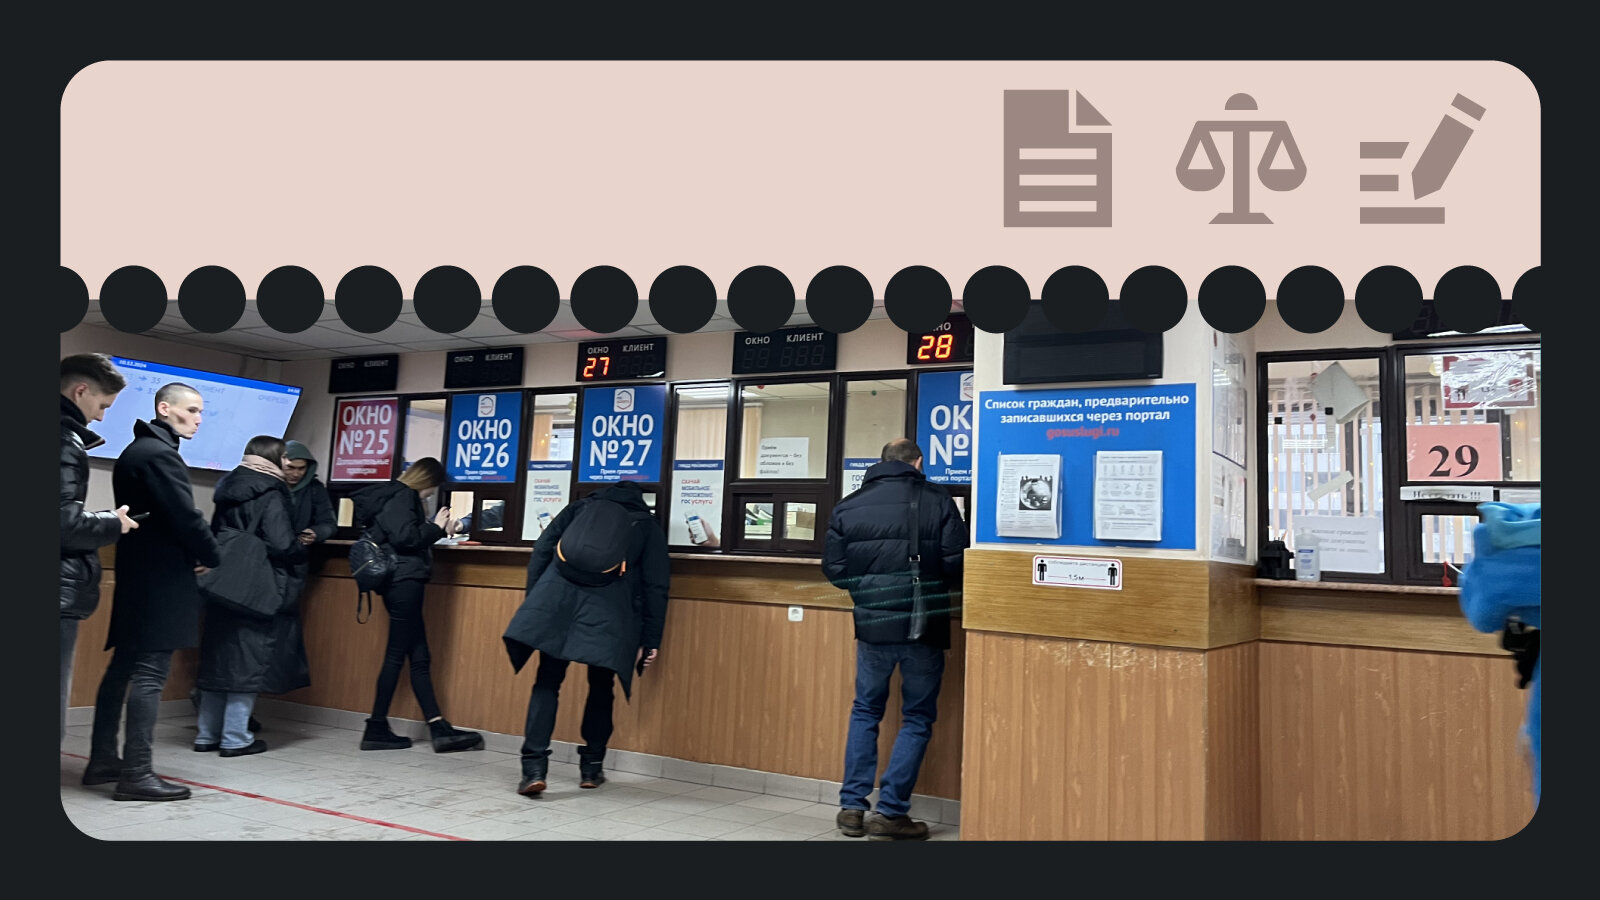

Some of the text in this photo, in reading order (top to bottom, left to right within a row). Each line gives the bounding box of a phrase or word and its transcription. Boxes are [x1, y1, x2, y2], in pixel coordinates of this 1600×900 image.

[588, 343, 654, 354] ОКНО КЛИЕНТ
[745, 332, 824, 345] ОКНО КЛИЕНТ
[917, 334, 952, 360] 28
[454, 352, 513, 363] ОКНО КЛИЕНТ
[583, 356, 610, 378] 27
[984, 395, 1189, 410] Список граждан, предварительно
[343, 404, 392, 425] ОКНО
[591, 414, 654, 437] ОКНО
[930, 404, 972, 431] ОК
[1000, 410, 1170, 424] записавшихся через портал
[458, 418, 512, 441] ОКНО
[1046, 426, 1119, 440] gosuslugi.ru
[339, 429, 389, 455] №25
[589, 439, 653, 467] №27
[455, 442, 509, 468] №26
[1428, 444, 1479, 478] 29
